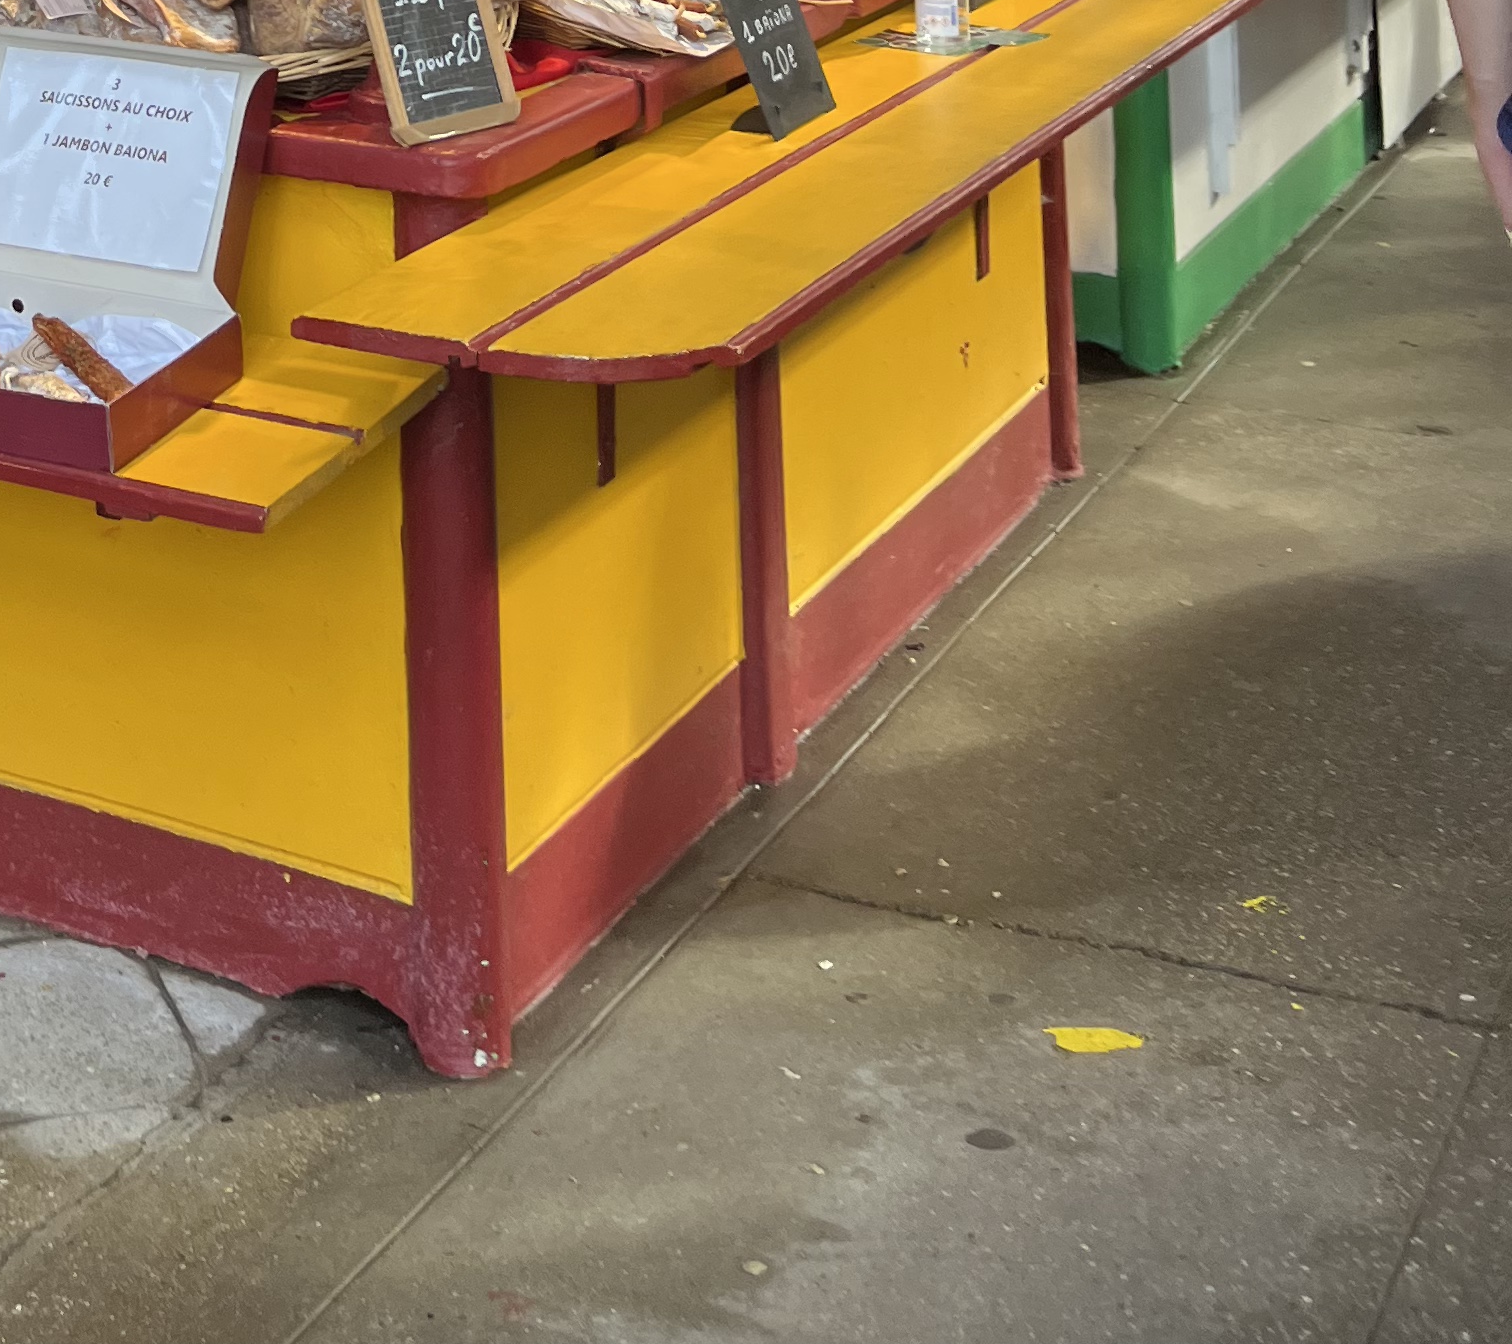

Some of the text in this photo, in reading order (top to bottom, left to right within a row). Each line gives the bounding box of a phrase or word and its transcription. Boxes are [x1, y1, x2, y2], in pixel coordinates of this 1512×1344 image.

[394, 43, 414, 78] 2
[415, 50, 456, 87] pour
[111, 78, 122, 91] 3
[39, 90, 194, 123] SAUCISSONS AU CHOIX
[42, 133, 168, 163] 1 JAMBON BAIONA
[84, 171, 114, 188] 20 €
